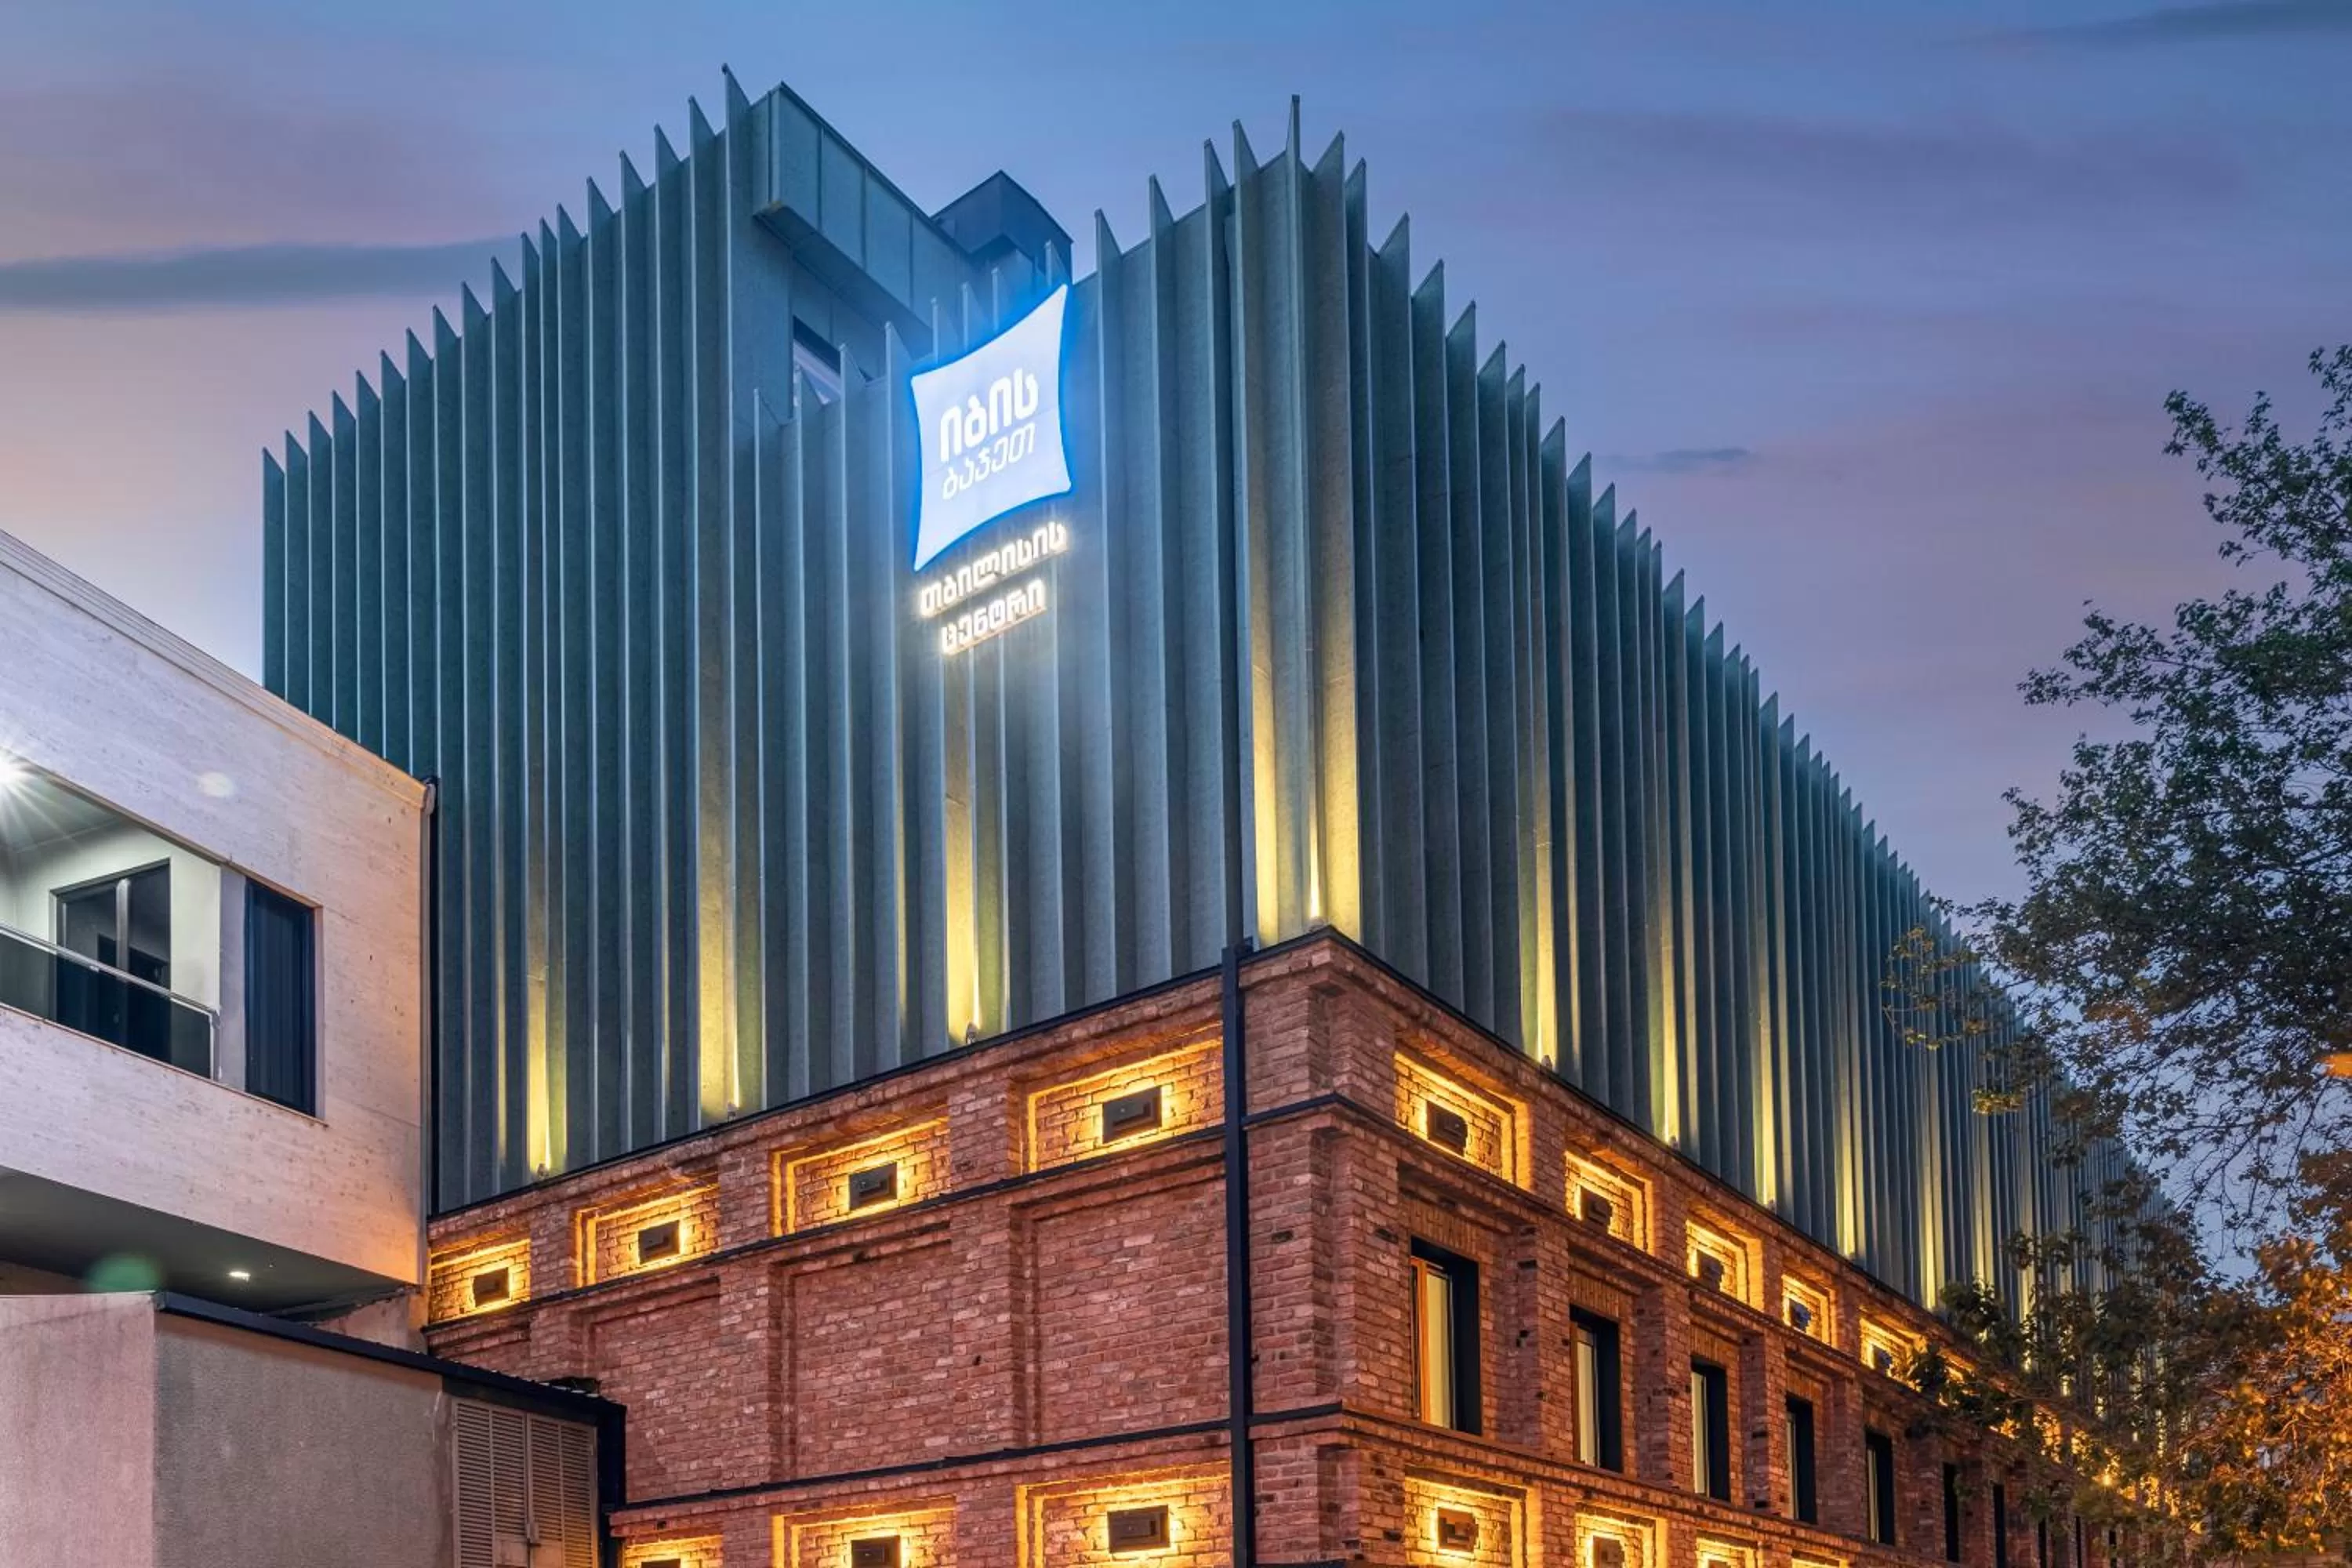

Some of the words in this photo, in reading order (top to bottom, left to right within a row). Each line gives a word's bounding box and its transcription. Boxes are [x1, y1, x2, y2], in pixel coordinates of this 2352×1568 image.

[940, 368, 1039, 463] იბის
[942, 423, 1036, 500] ბაჯეთ
[920, 521, 1067, 619] თბილისის
[941, 578, 1045, 655] ცენტრი
